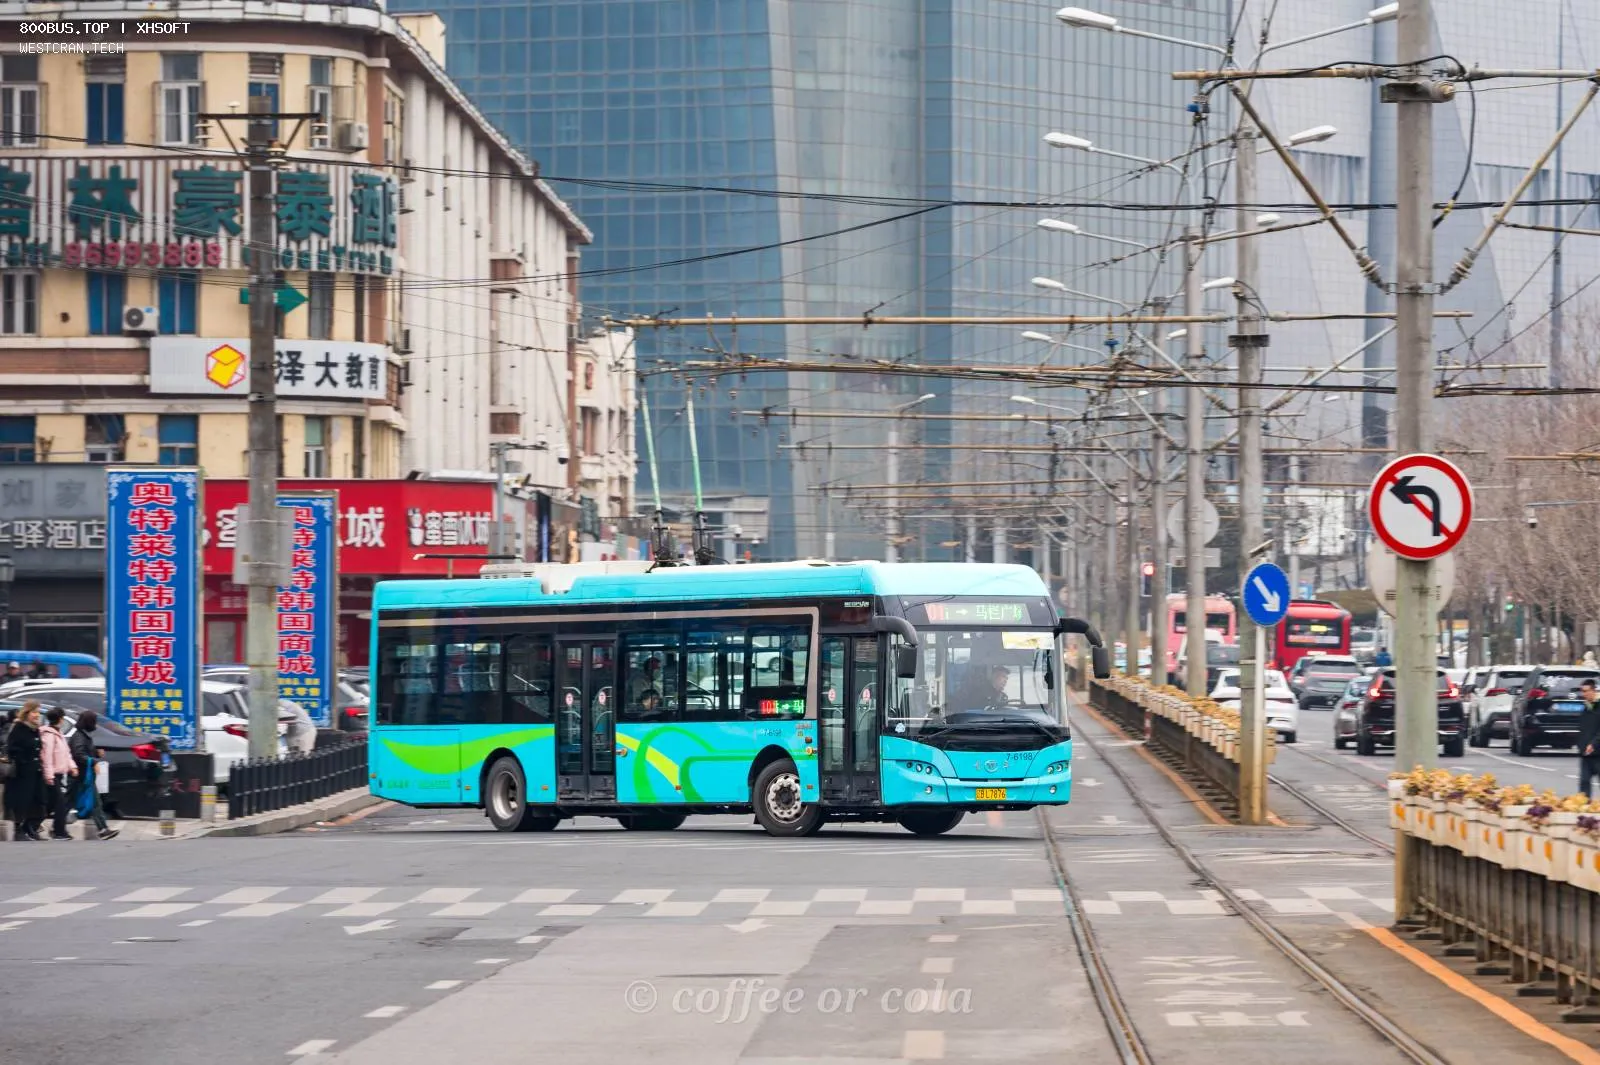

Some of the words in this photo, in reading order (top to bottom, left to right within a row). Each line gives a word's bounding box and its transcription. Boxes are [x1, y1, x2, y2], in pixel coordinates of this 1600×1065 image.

[275, 350, 379, 390] 泽大教育
[127, 482, 177, 685] 奥特莱特韩国商城
[1006, 752, 1034, 761] 7-6198
